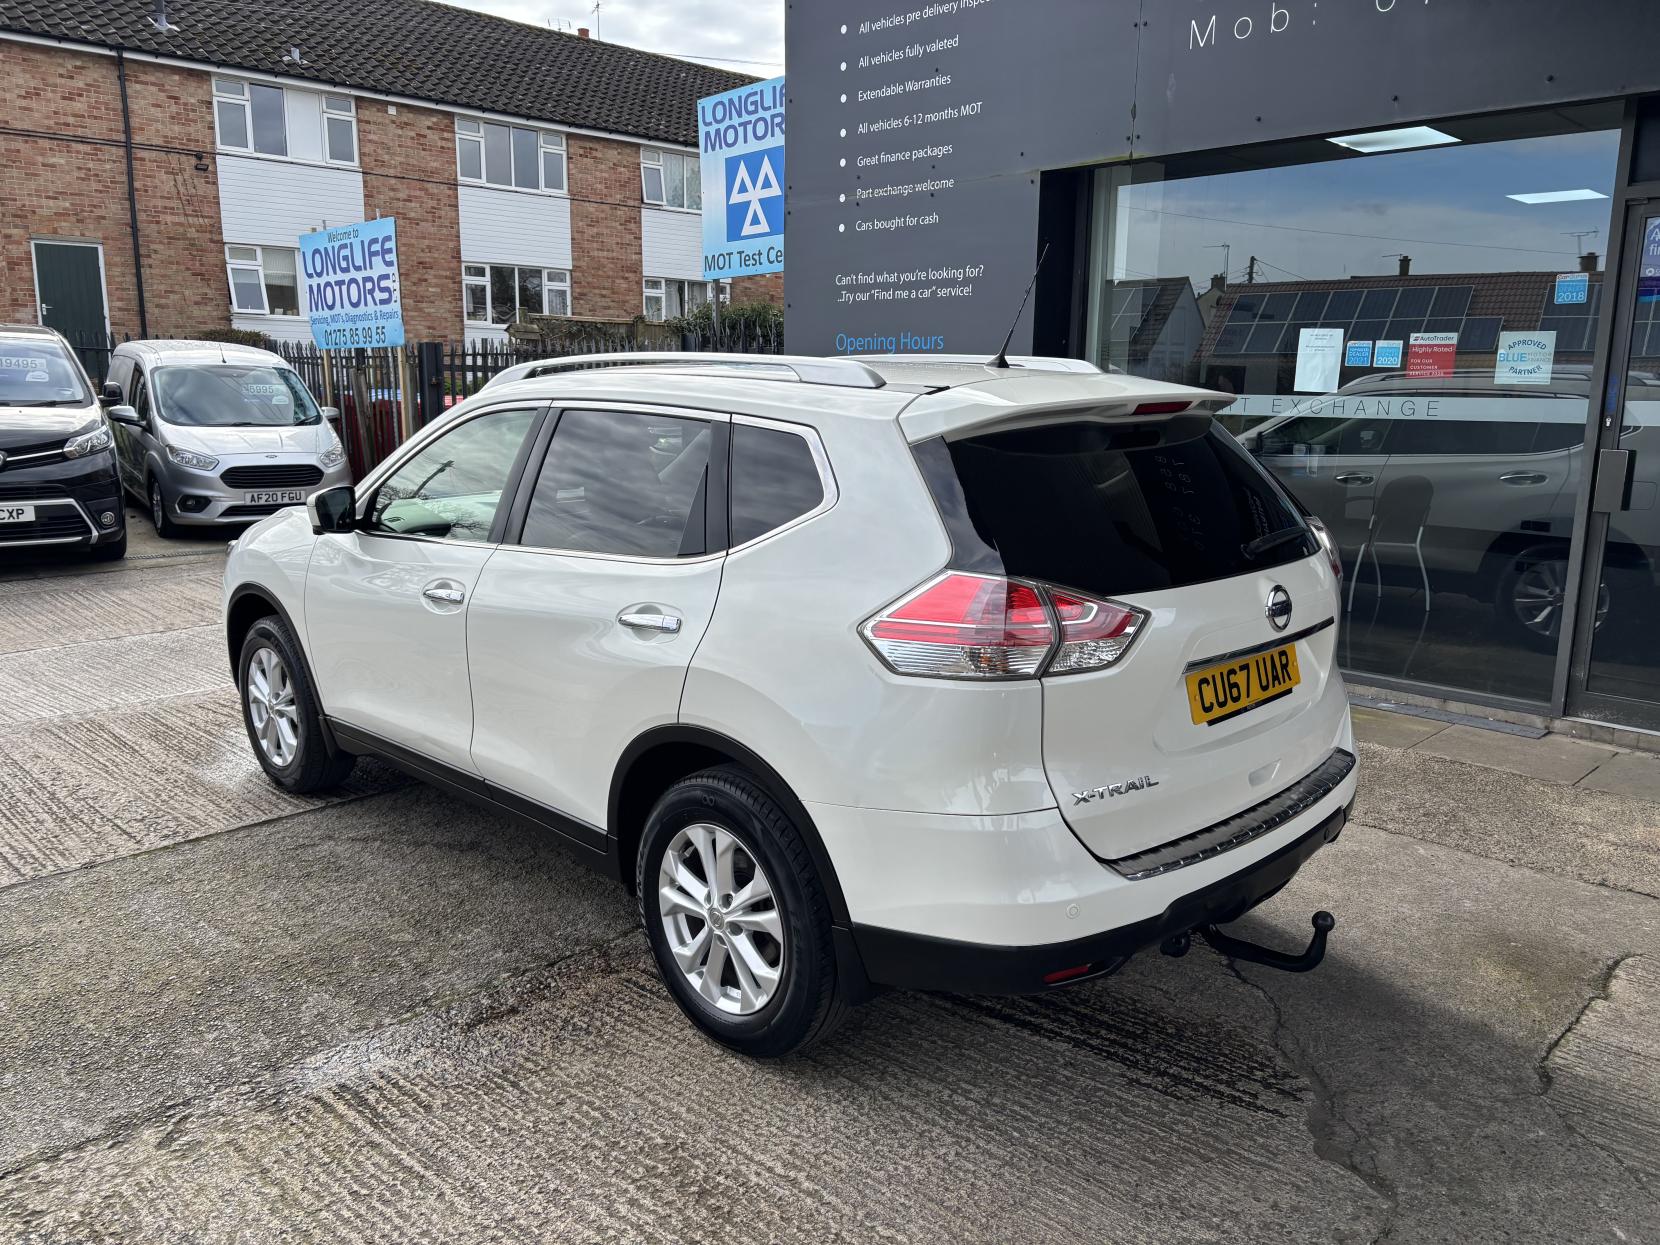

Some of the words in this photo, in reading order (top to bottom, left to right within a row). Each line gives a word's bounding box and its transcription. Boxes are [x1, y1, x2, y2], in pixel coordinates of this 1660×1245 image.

[858, 20, 870, 34] All
[871, 14, 904, 31] vehicles
[906, 10, 920, 26] pre
[922, 1, 958, 18] delivery
[858, 56, 869, 68] All
[870, 49, 904, 65] vehicles
[906, 44, 924, 58] fully
[926, 34, 959, 52] valeted
[858, 83, 904, 102] Extendable
[905, 74, 952, 92] Warranties
[858, 123, 868, 134] All
[870, 118, 902, 132] vehicles
[904, 114, 923, 126] 6-12
[924, 108, 958, 122] months
[960, 102, 982, 116] MOT
[857, 154, 878, 166] Great
[880, 152, 910, 163] finance
[912, 144, 952, 161] packages
[856, 188, 872, 198] Part
[874, 184, 914, 196] exchange
[915, 178, 954, 192] welcome
[856, 220, 872, 231] Cars
[874, 216, 904, 230] bought
[906, 214, 918, 226] for
[920, 212, 939, 224] cash
[328, 230, 352, 244] Welcome
[352, 228, 359, 238] to
[302, 235, 394, 279] LONGLIFE
[704, 252, 734, 272] MOT
[737, 249, 763, 269] Test
[836, 274, 856, 286] Can't
[858, 272, 874, 284] find
[876, 272, 898, 284] what
[900, 270, 926, 284] you're
[928, 267, 963, 280] looking
[966, 264, 984, 278] for?
[308, 274, 393, 312] MOTORS
[856, 292, 870, 300] our
[895, 290, 908, 299] me
[910, 290, 916, 298] a
[937, 284, 972, 296] service!
[1558, 290, 1584, 302] 2018
[345, 311, 373, 324] Diagnostics
[374, 310, 379, 321] &
[380, 309, 398, 322] Repairs
[324, 328, 348, 346] 01275
[350, 328, 360, 345] 85
[362, 326, 372, 344] 99
[376, 326, 386, 344] 55
[836, 332, 896, 354] Opening
[900, 332, 944, 350] Hours
[1508, 340, 1546, 350] APPROVED
[1498, 352, 1527, 362] BLUE
[1508, 364, 1542, 376] PARTNER
[1272, 398, 1440, 417] EXCHANGE
[250, 493, 278, 504] AF20
[281, 492, 302, 502] FGU
[1198, 662, 1250, 714] CU67
[1256, 650, 1292, 692] UAR
[1072, 776, 1159, 806] X-TRAIL
